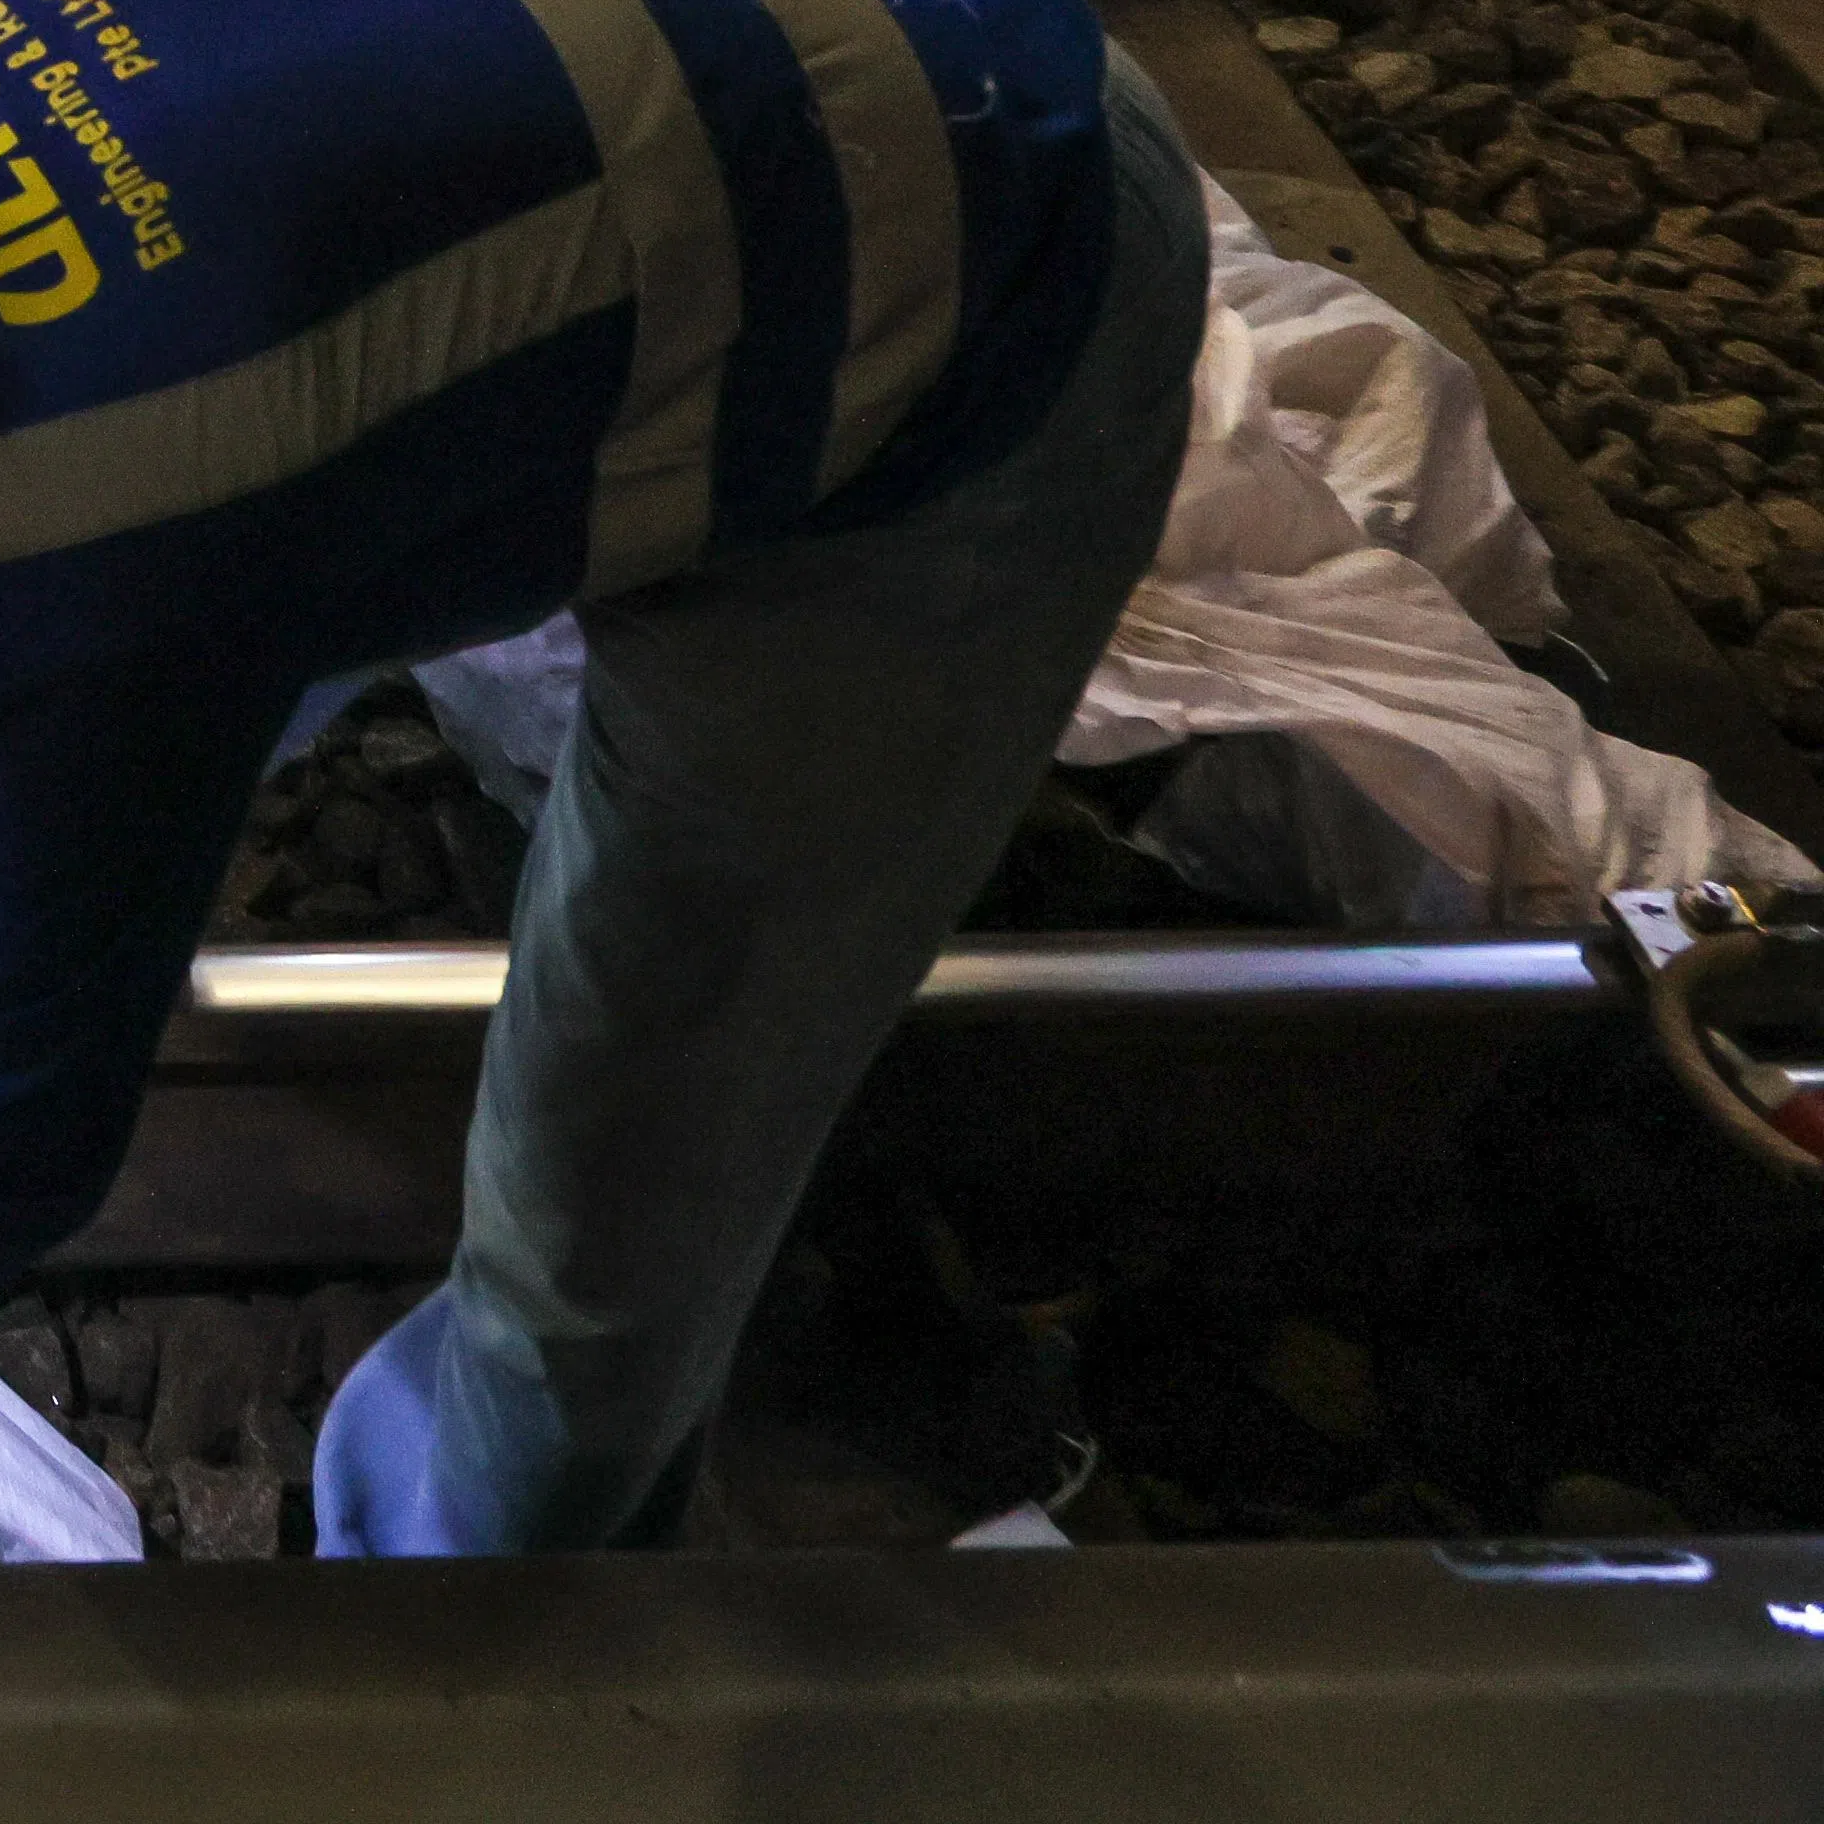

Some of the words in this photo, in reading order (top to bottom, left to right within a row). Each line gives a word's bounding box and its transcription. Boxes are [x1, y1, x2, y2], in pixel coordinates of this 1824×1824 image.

[7, 37, 47, 70] &
[97, 24, 160, 80] Pte
[31, 60, 186, 272] Engineering
